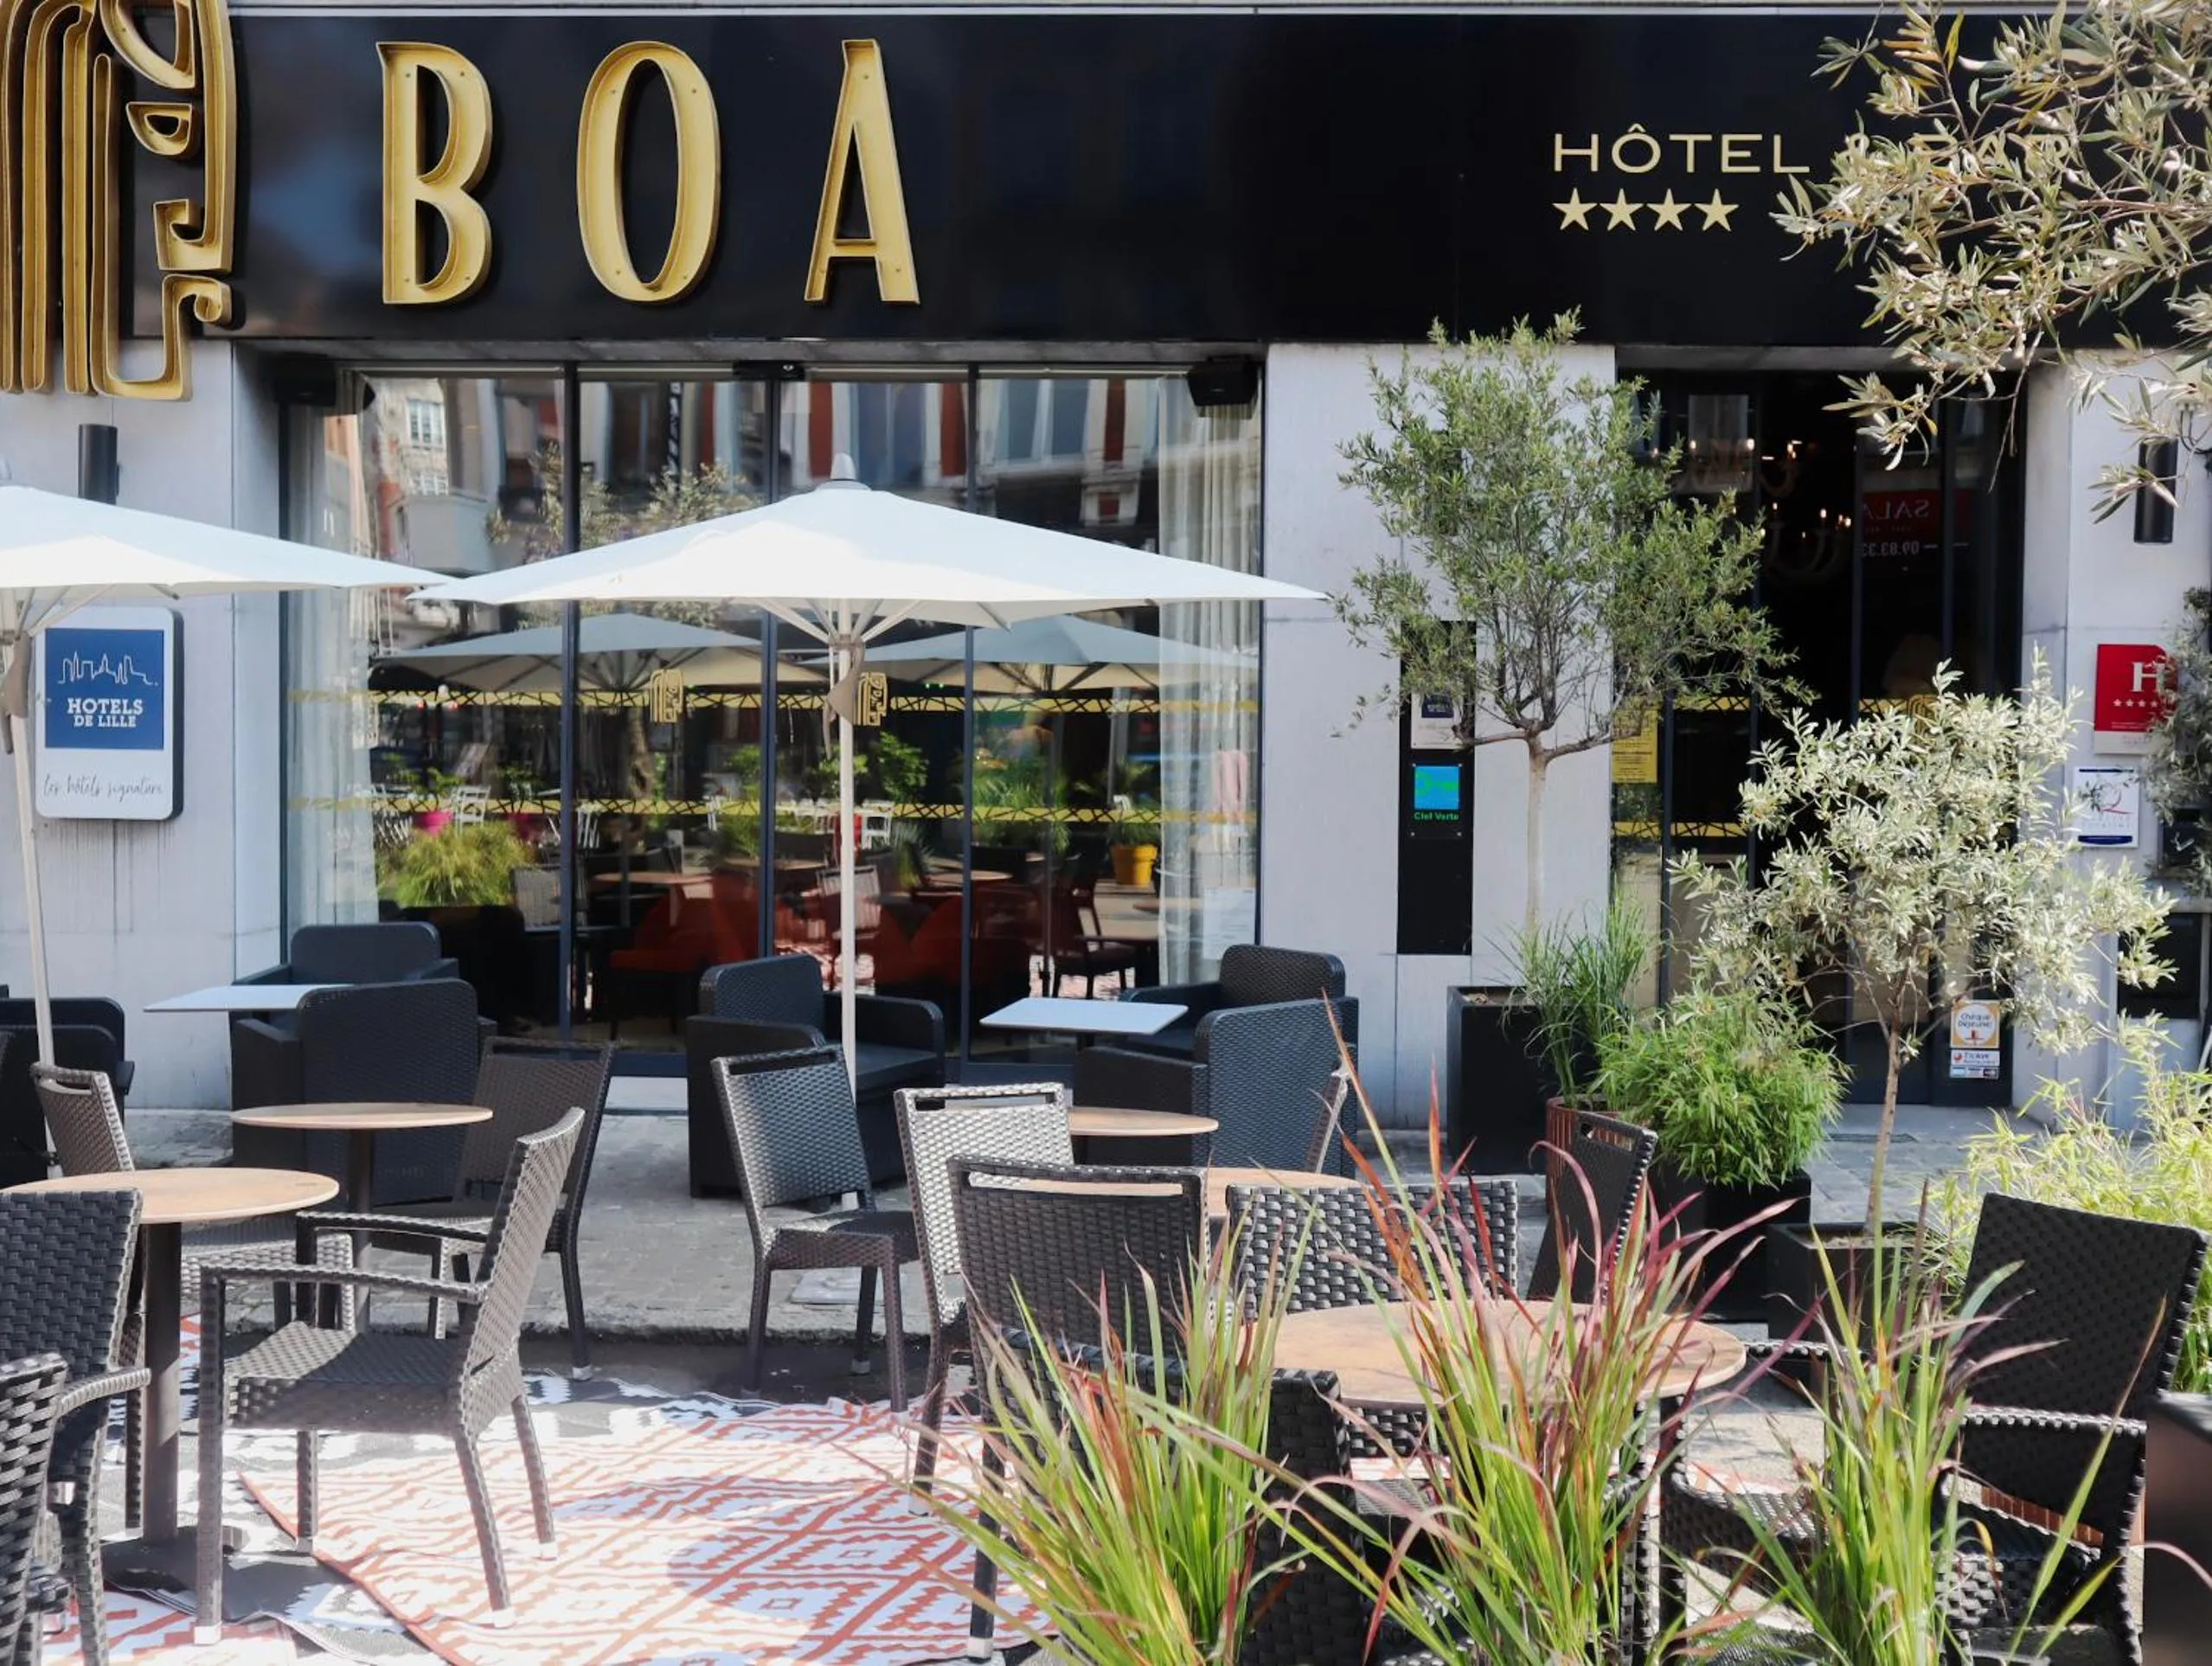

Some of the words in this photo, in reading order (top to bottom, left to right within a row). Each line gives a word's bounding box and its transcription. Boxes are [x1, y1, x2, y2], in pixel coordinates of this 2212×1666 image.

[1554, 123, 1811, 173] HÔTEL
[377, 39, 920, 304] BOA
[2131, 662, 2165, 692] H
[67, 697, 144, 714] HOTELS
[74, 715, 93, 727] DE
[98, 714, 137, 727] LILLE
